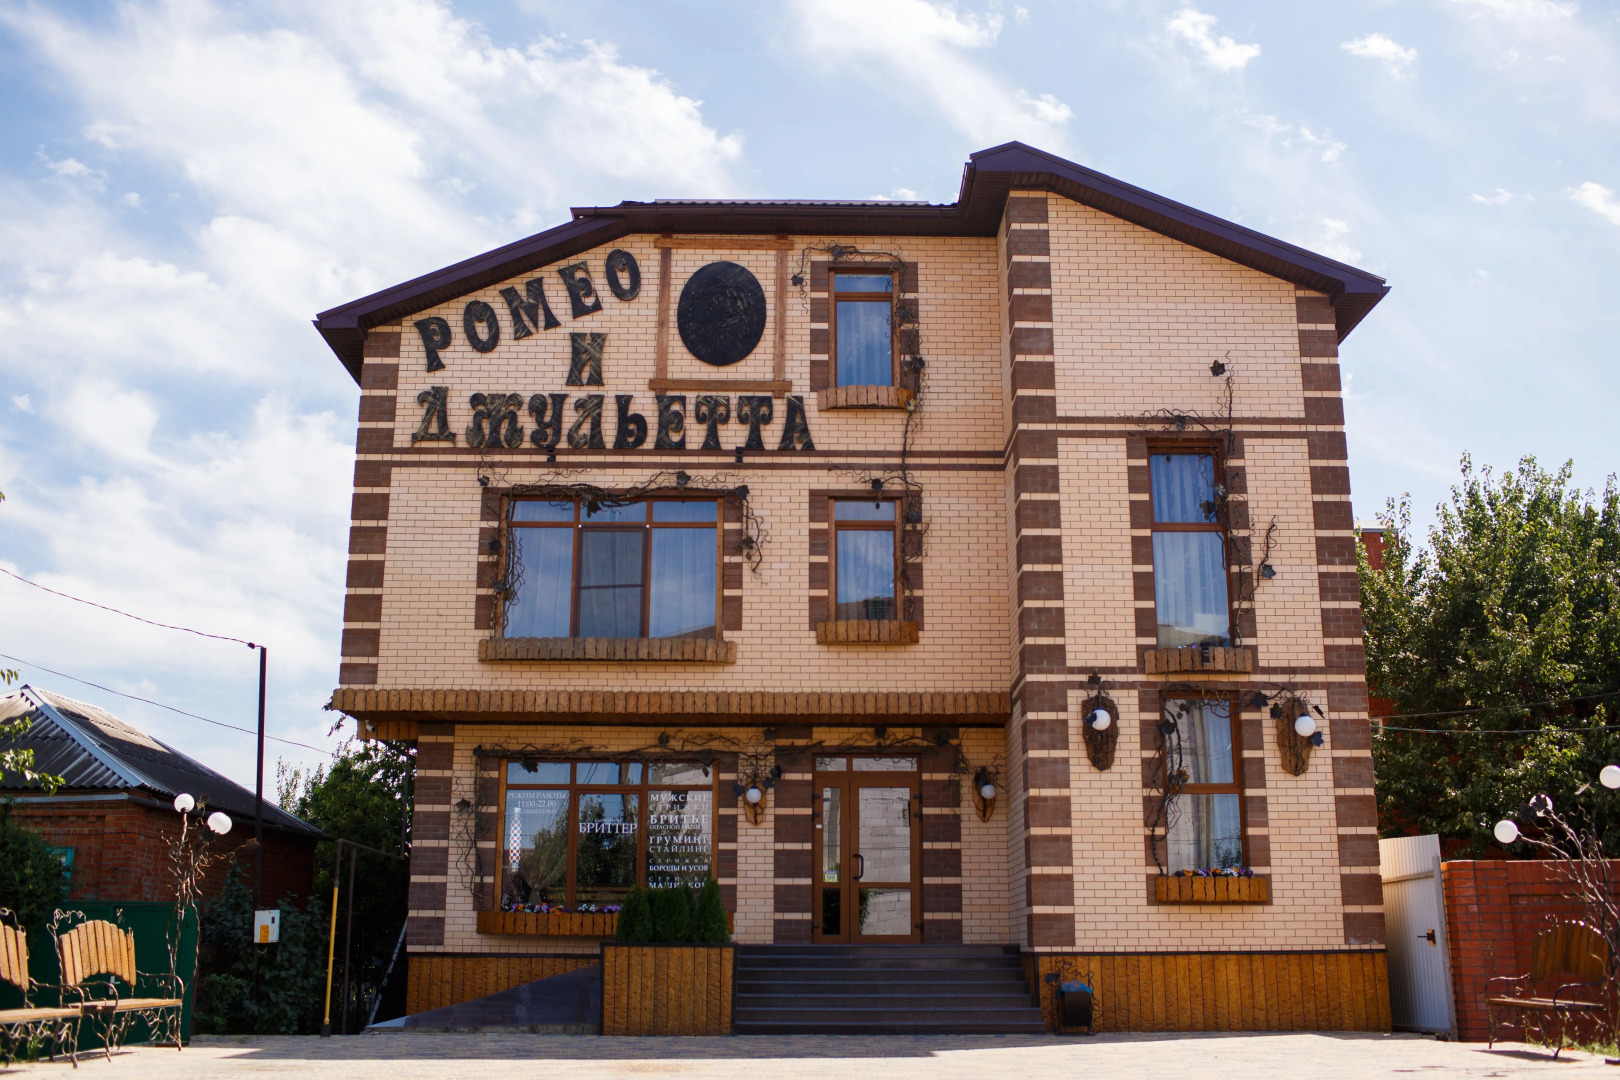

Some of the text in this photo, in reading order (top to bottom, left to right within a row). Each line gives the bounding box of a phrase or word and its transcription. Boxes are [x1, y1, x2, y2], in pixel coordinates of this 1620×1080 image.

[413, 248, 641, 372] РОМЕО
[566, 332, 608, 386] И
[411, 386, 816, 451] ДЖУЛЬЕТТА
[650, 793, 709, 803] МУЖСКИЕ
[650, 814, 709, 824] БРИТЬЕ
[579, 822, 638, 834] БРИТТЕР
[649, 835, 708, 845] ГРУМИНГ
[649, 844, 709, 853] СТАЙЛИНГ
